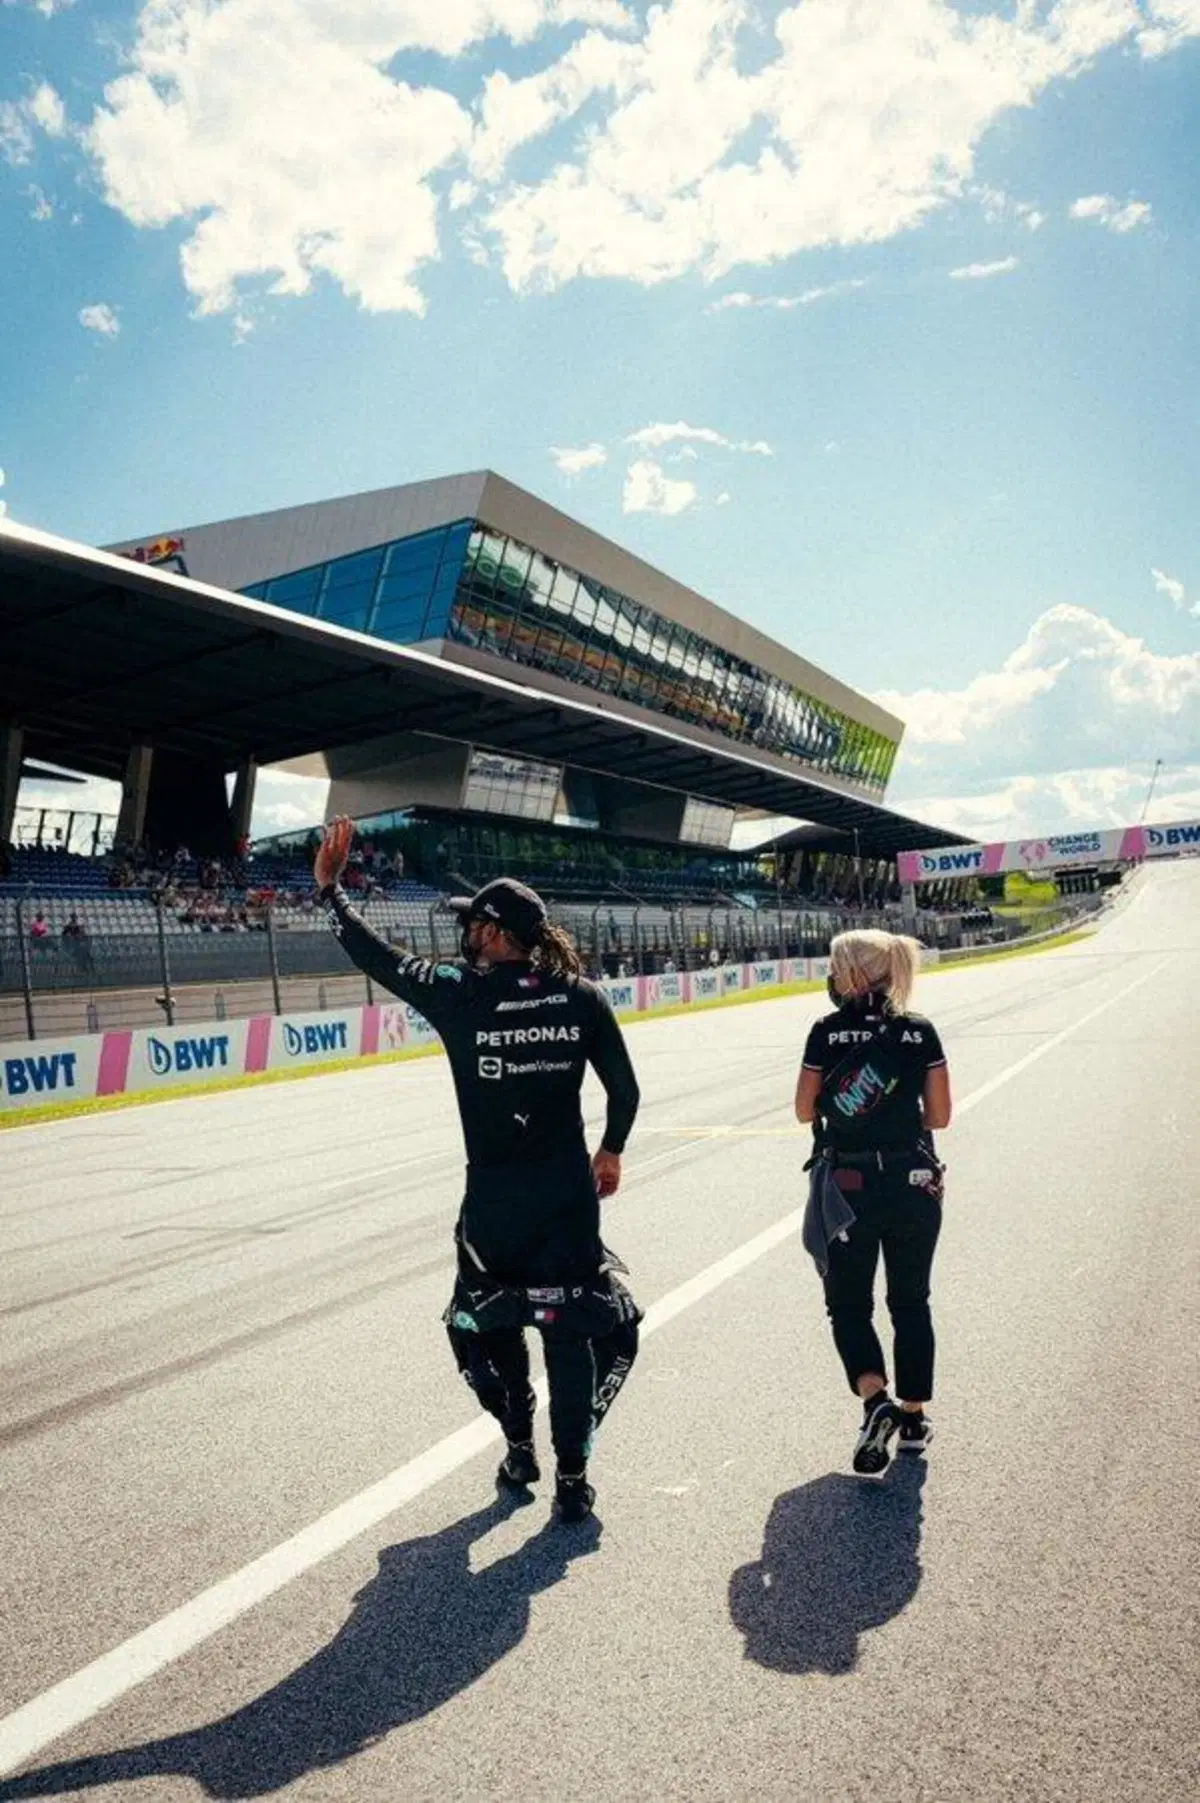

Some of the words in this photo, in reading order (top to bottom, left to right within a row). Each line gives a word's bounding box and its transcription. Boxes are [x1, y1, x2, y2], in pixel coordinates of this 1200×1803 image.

[1048, 832, 1099, 847] CHANGE
[1166, 826, 1200, 845] BW
[939, 852, 983, 870] BWT
[304, 1020, 347, 1053] BWT
[476, 1026, 580, 1047] PETRONAS
[828, 1030, 923, 1045] PETRAS
[173, 1036, 229, 1072] BWT
[5, 1053, 76, 1095] BWT
[591, 1355, 631, 1411] INEOS
